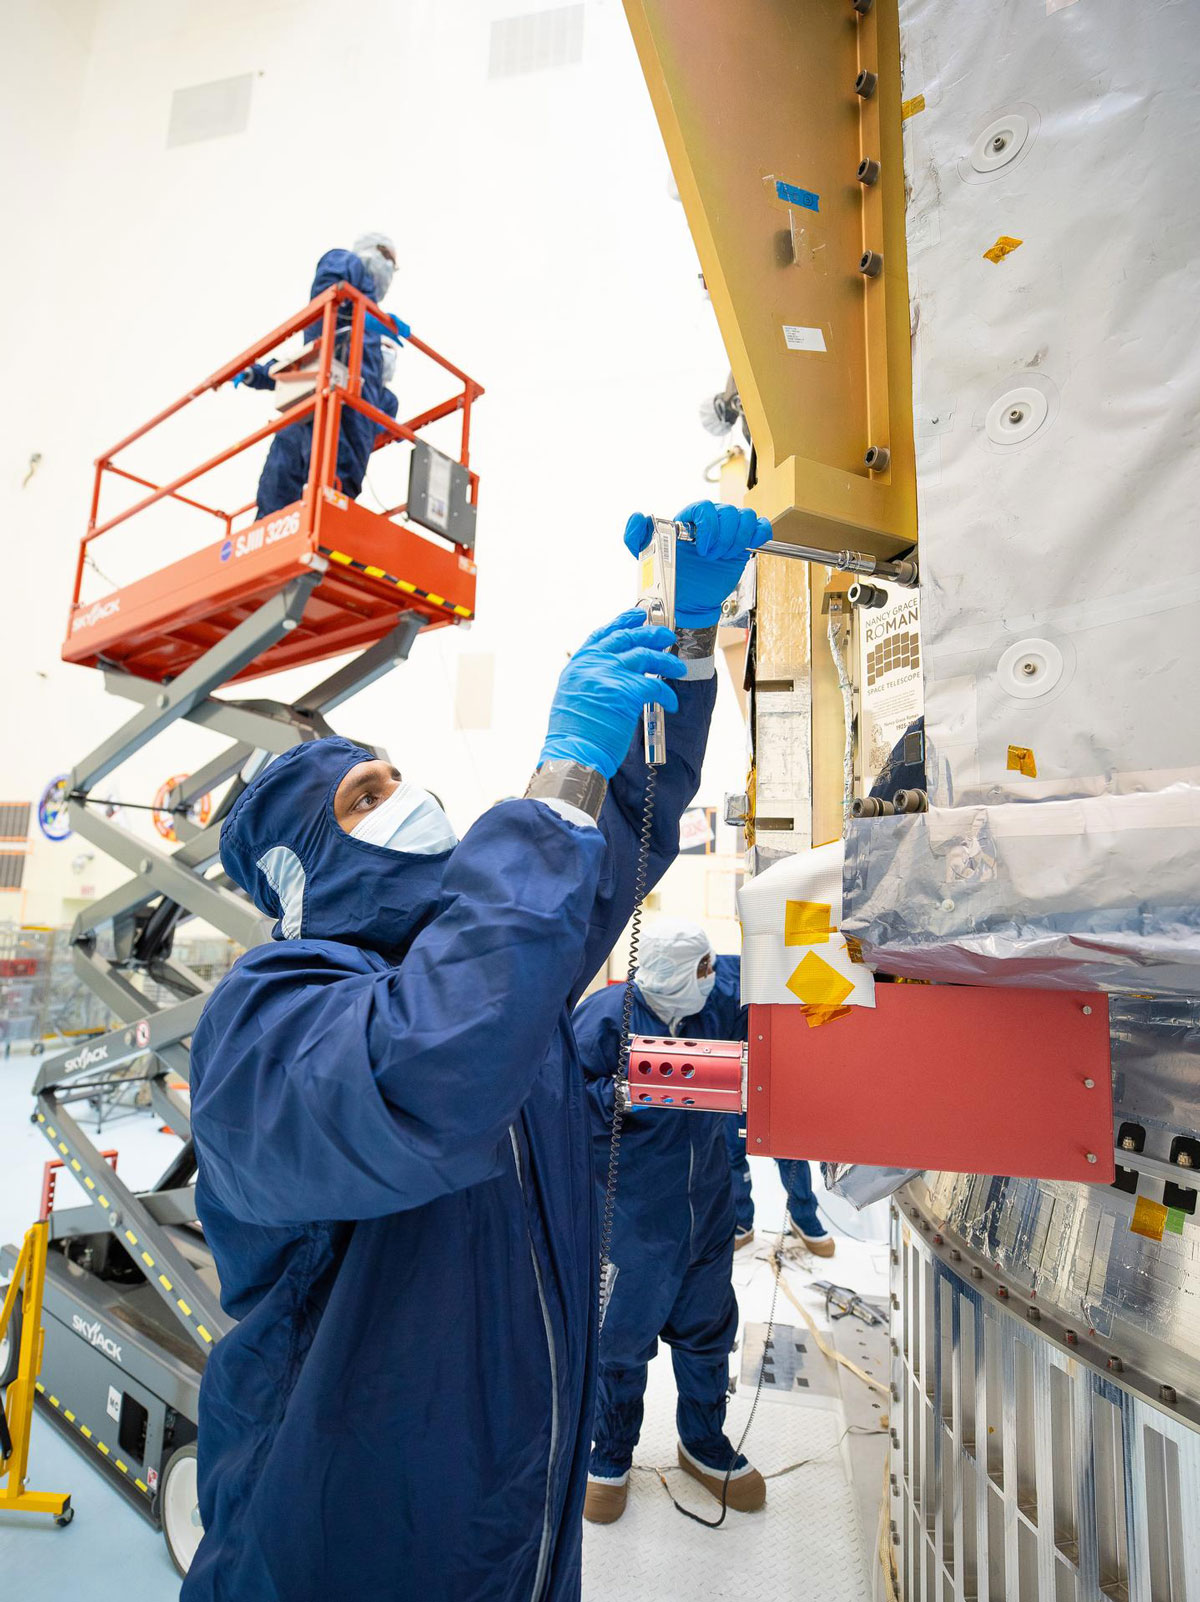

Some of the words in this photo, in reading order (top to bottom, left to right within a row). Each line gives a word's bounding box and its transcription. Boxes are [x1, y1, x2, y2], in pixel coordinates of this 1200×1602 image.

[265, 512, 300, 545] 3226
[866, 611, 890, 628] NANCY
[892, 597, 918, 616] GRACE
[866, 607, 918, 643] ROMAN
[867, 684, 885, 696] SPACE
[886, 672, 920, 689] TELESCOPE
[64, 1045, 109, 1073] SKYJACK
[72, 1314, 122, 1362] SKYJACK
